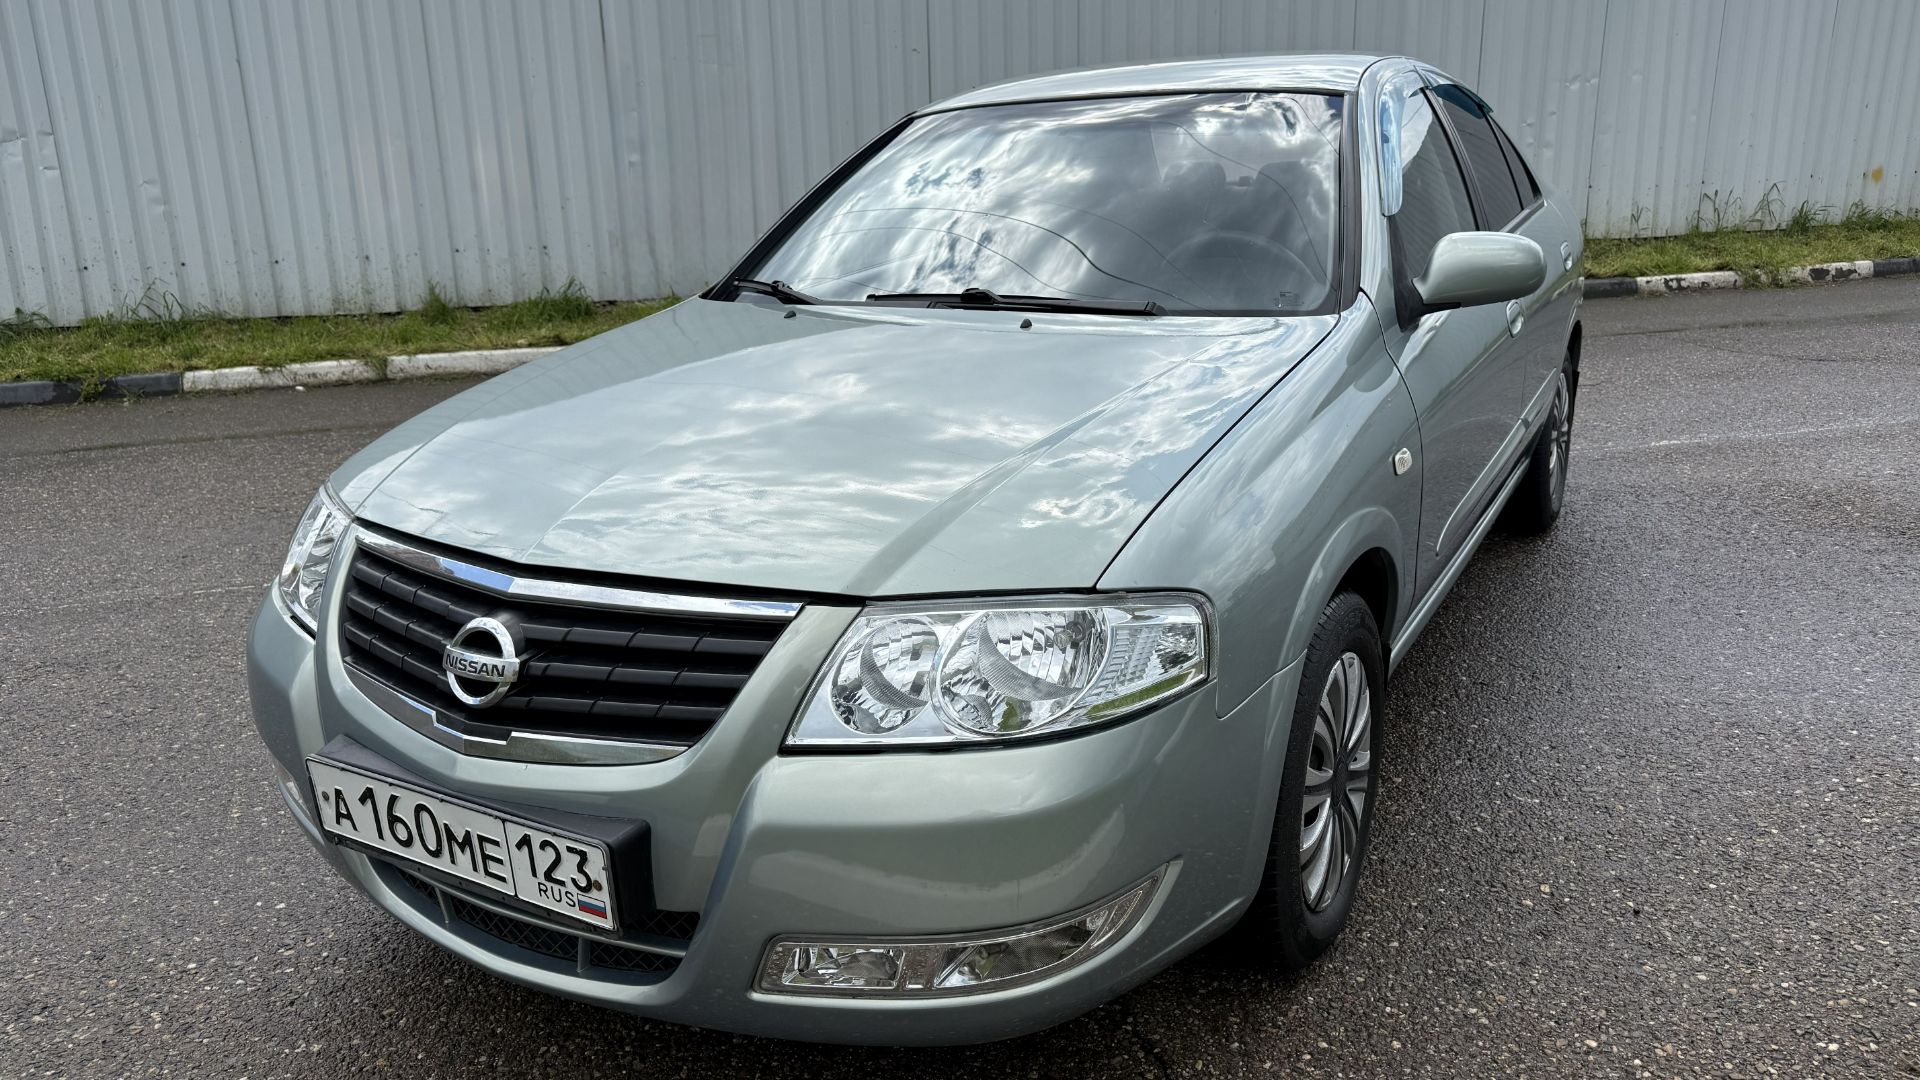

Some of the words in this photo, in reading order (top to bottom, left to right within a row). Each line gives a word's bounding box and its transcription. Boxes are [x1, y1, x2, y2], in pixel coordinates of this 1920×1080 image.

[445, 654, 506, 678] NISSAN
[515, 834, 594, 893] 123
[537, 881, 577, 909] RUS
